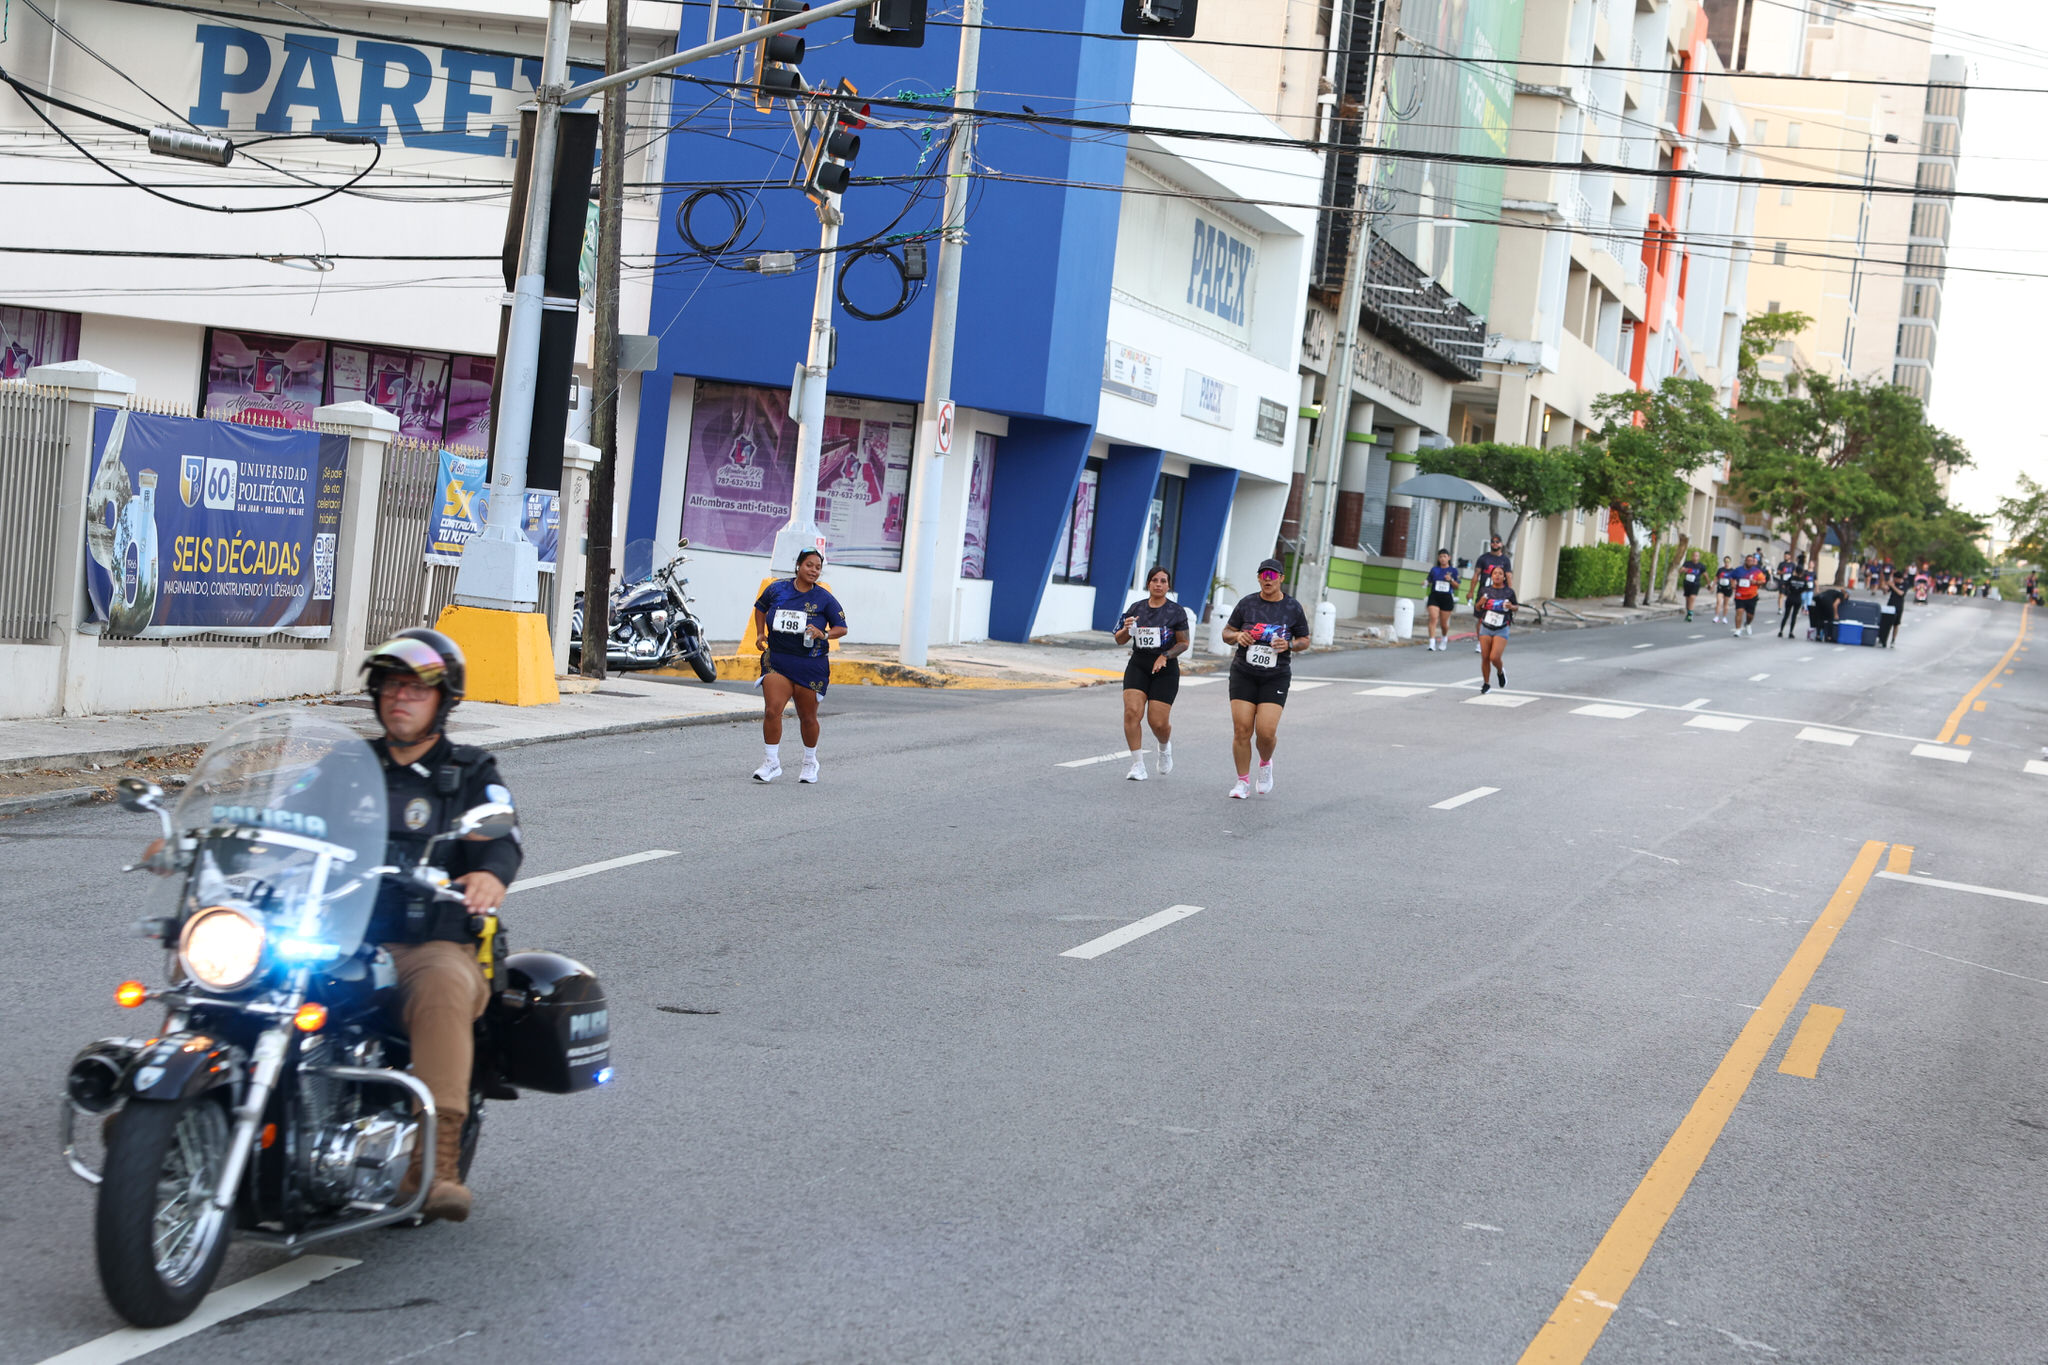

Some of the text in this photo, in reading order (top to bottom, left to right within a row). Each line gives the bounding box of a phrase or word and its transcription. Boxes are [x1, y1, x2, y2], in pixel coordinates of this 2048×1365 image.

[1187, 217, 1251, 327] PAREX
[226, 395, 305, 416] Alfombras PR
[240, 462, 308, 481] UNIVERSIDAD
[207, 466, 232, 501] 60
[717, 477, 761, 488] 787-632-9321
[238, 480, 305, 505] POLITÉCNICA
[827, 490, 871, 501] 787-632-9321
[237, 503, 247, 512] SAN
[247, 504, 260, 513] JUAN
[264, 505, 285, 515] ORLANDO
[690, 496, 788, 516] Alfombras anti-fatigas
[172, 530, 301, 577] SEIS DÉCADAS
[210, 581, 263, 597] CONSTRUYENDO
[263, 583, 270, 597] Y
[780, 620, 799, 631] 198
[1138, 636, 1154, 646] 192
[1252, 653, 1271, 666] 208
